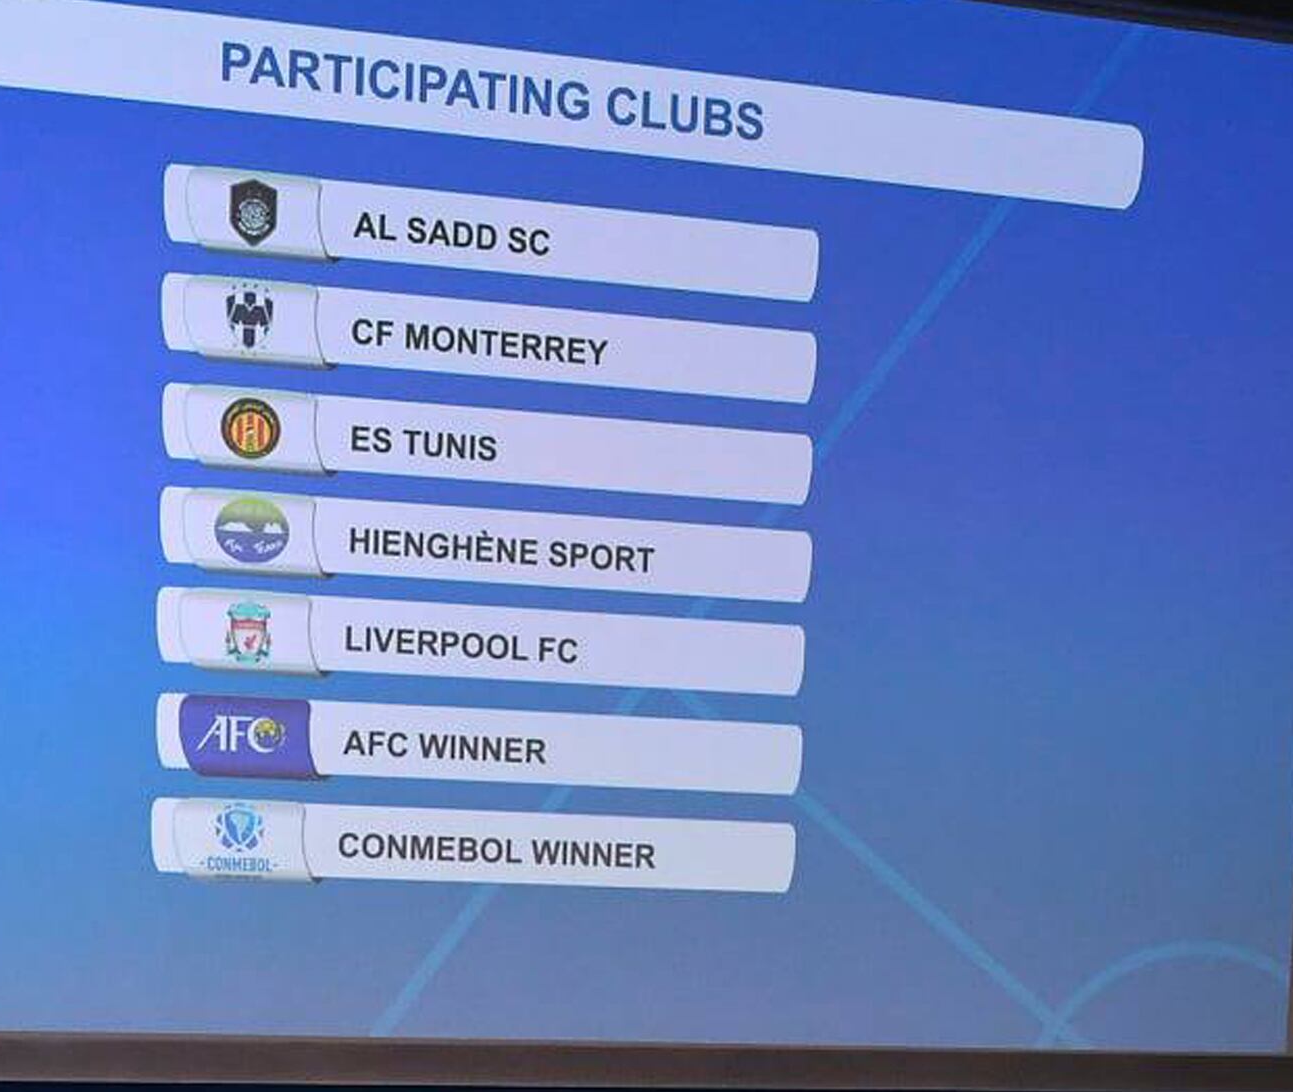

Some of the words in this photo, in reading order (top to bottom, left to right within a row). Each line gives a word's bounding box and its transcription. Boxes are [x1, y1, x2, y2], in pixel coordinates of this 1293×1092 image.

[221, 41, 590, 121] PARTICIPATING
[607, 87, 765, 140] CLUBS
[354, 212, 397, 241] AL
[407, 217, 498, 252] SADD
[507, 227, 551, 257] SC
[351, 318, 395, 349] CF
[406, 322, 608, 366] MONTERREY
[350, 427, 393, 458] ES
[403, 429, 498, 464] TUNIS
[349, 525, 538, 568] HIENGHÈNE
[549, 541, 656, 574] SPORT
[345, 625, 529, 662] LIVERPOOL
[539, 637, 578, 664] FC
[197, 715, 285, 753] AFC
[343, 730, 409, 758] AFC
[418, 732, 547, 765] WINNER
[338, 832, 522, 865] CONMEBOL
[532, 839, 656, 870] WINNER
